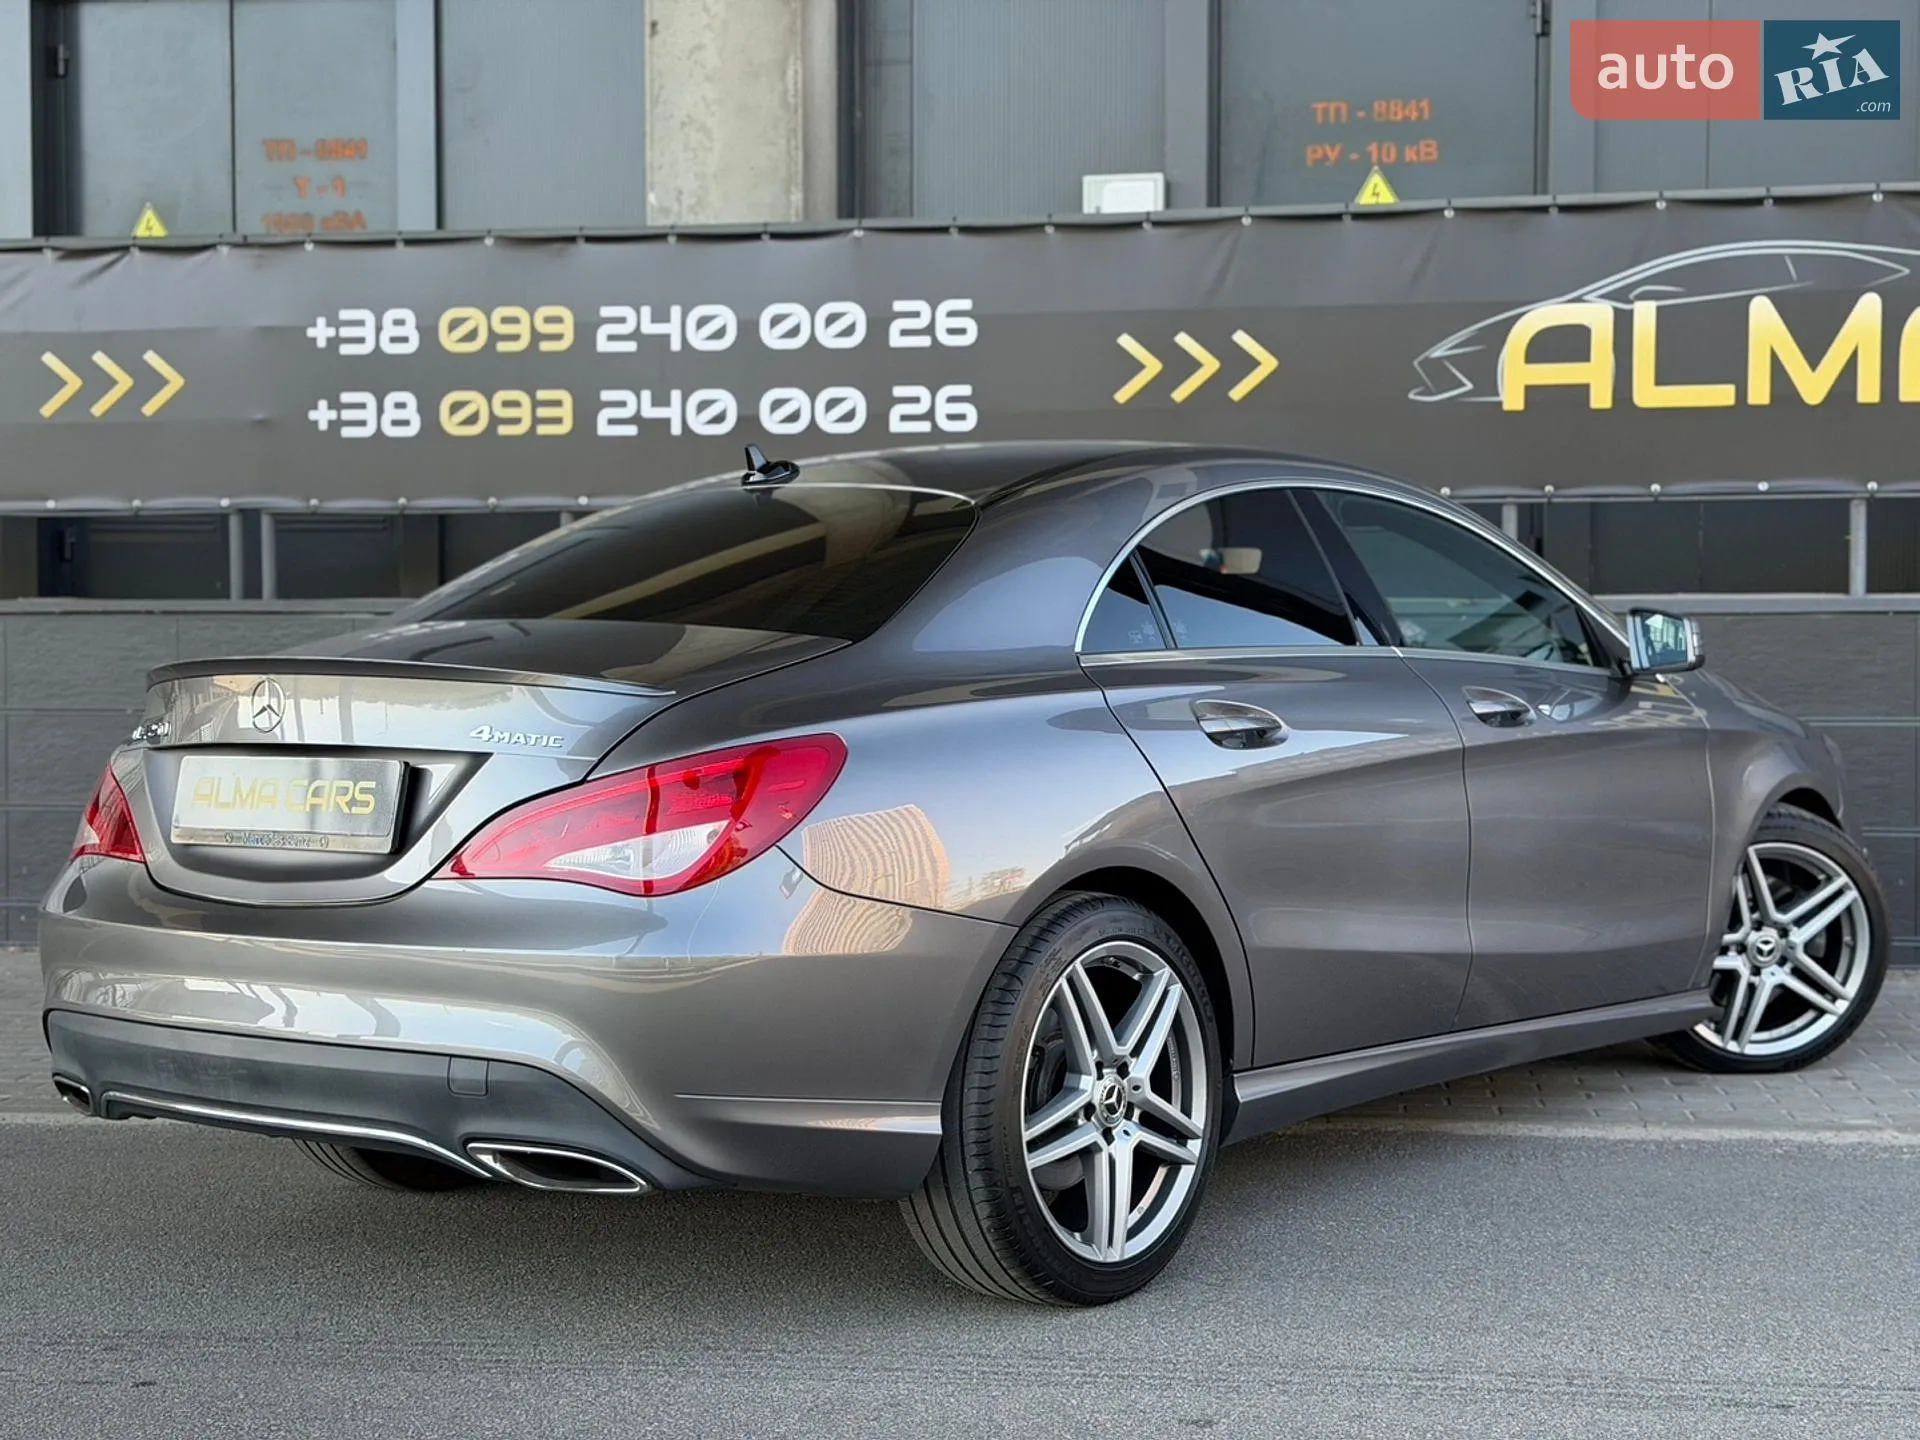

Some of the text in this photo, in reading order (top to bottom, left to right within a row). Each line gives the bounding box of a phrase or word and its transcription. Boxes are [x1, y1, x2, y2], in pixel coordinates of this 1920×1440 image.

[1311, 101, 1349, 125] ТП
[1373, 98, 1430, 121] 8841
[1305, 143, 1342, 168] РУ
[1365, 141, 1397, 164] 10
[306, 298, 978, 355] +38 099 240 00 26
[1502, 292, 1920, 411] ALM
[307, 384, 978, 438] +38 093 240 00 26
[469, 724, 564, 748] 4MATIC
[191, 776, 377, 816] ALMA CARS
